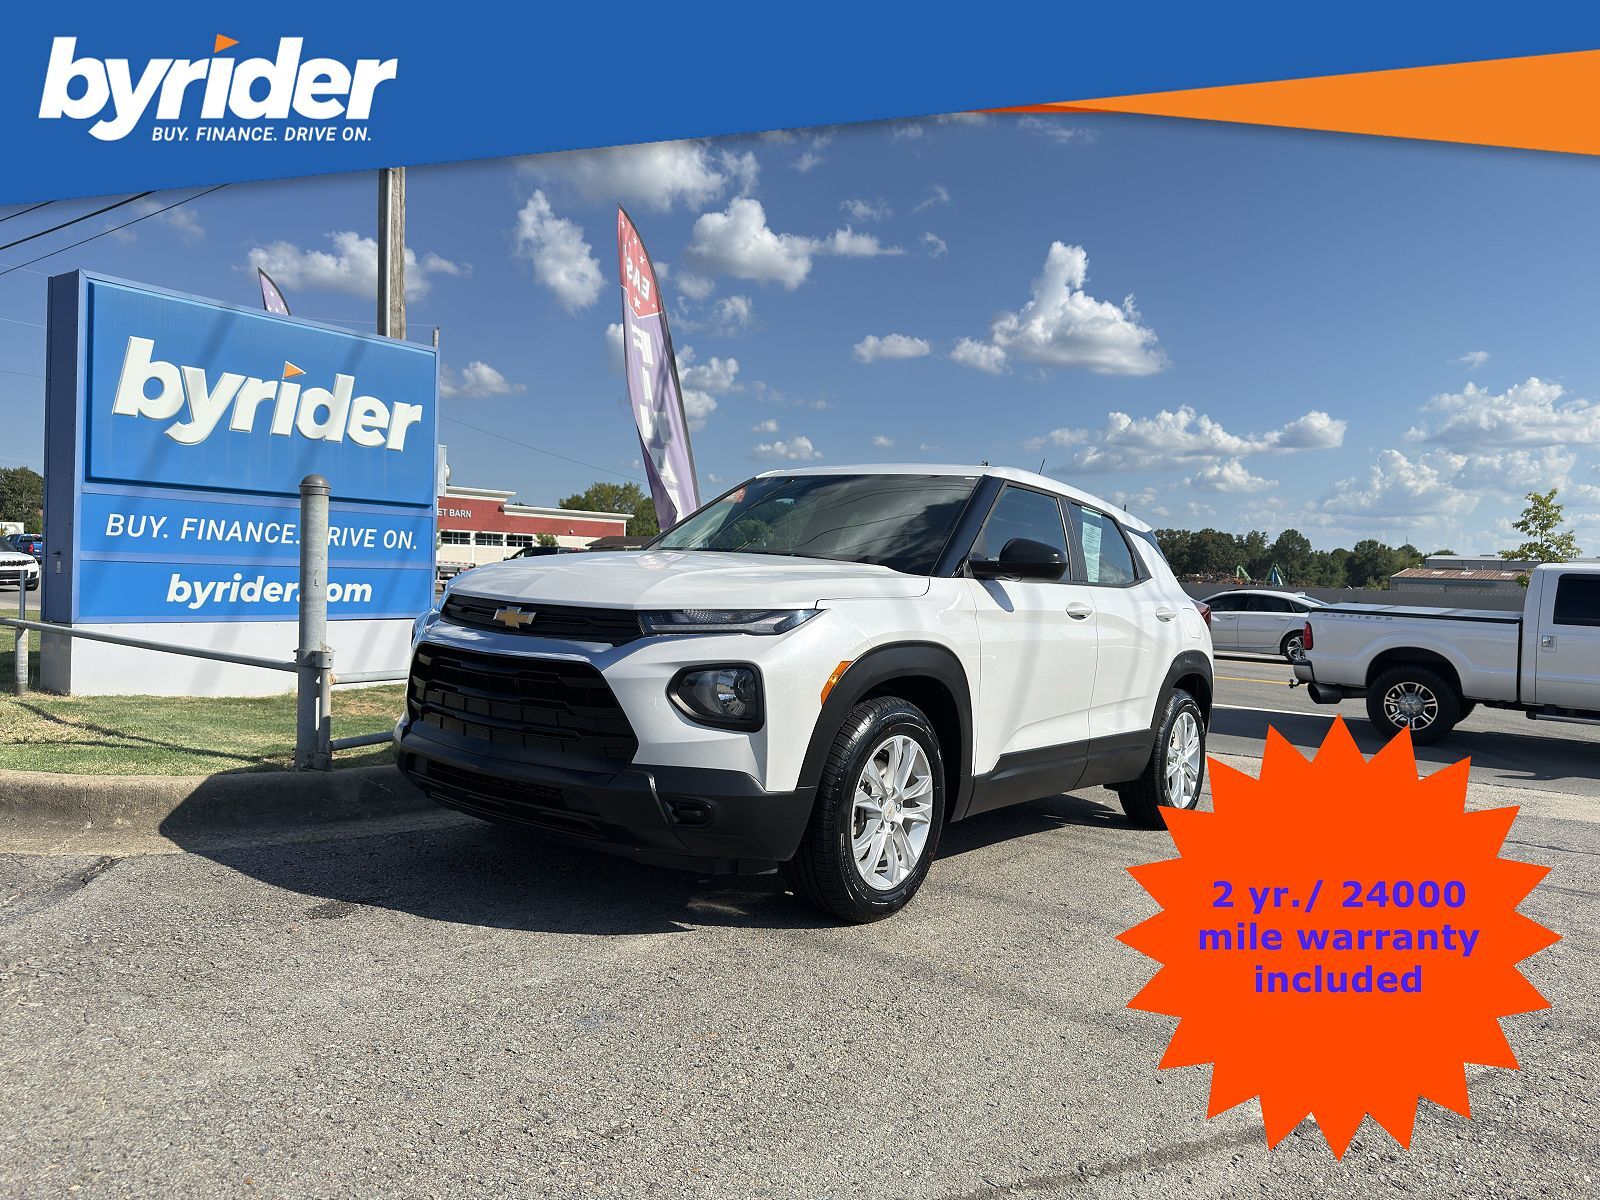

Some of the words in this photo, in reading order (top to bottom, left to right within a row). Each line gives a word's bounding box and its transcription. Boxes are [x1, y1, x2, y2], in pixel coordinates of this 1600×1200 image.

[112, 335, 423, 452] byrider
[449, 508, 472, 518] BARN
[105, 513, 169, 539] BUY.
[180, 517, 300, 545] FINANCE.
[327, 526, 378, 548] RIVE
[383, 529, 417, 550] ON.
[166, 573, 373, 609] byrider.om
